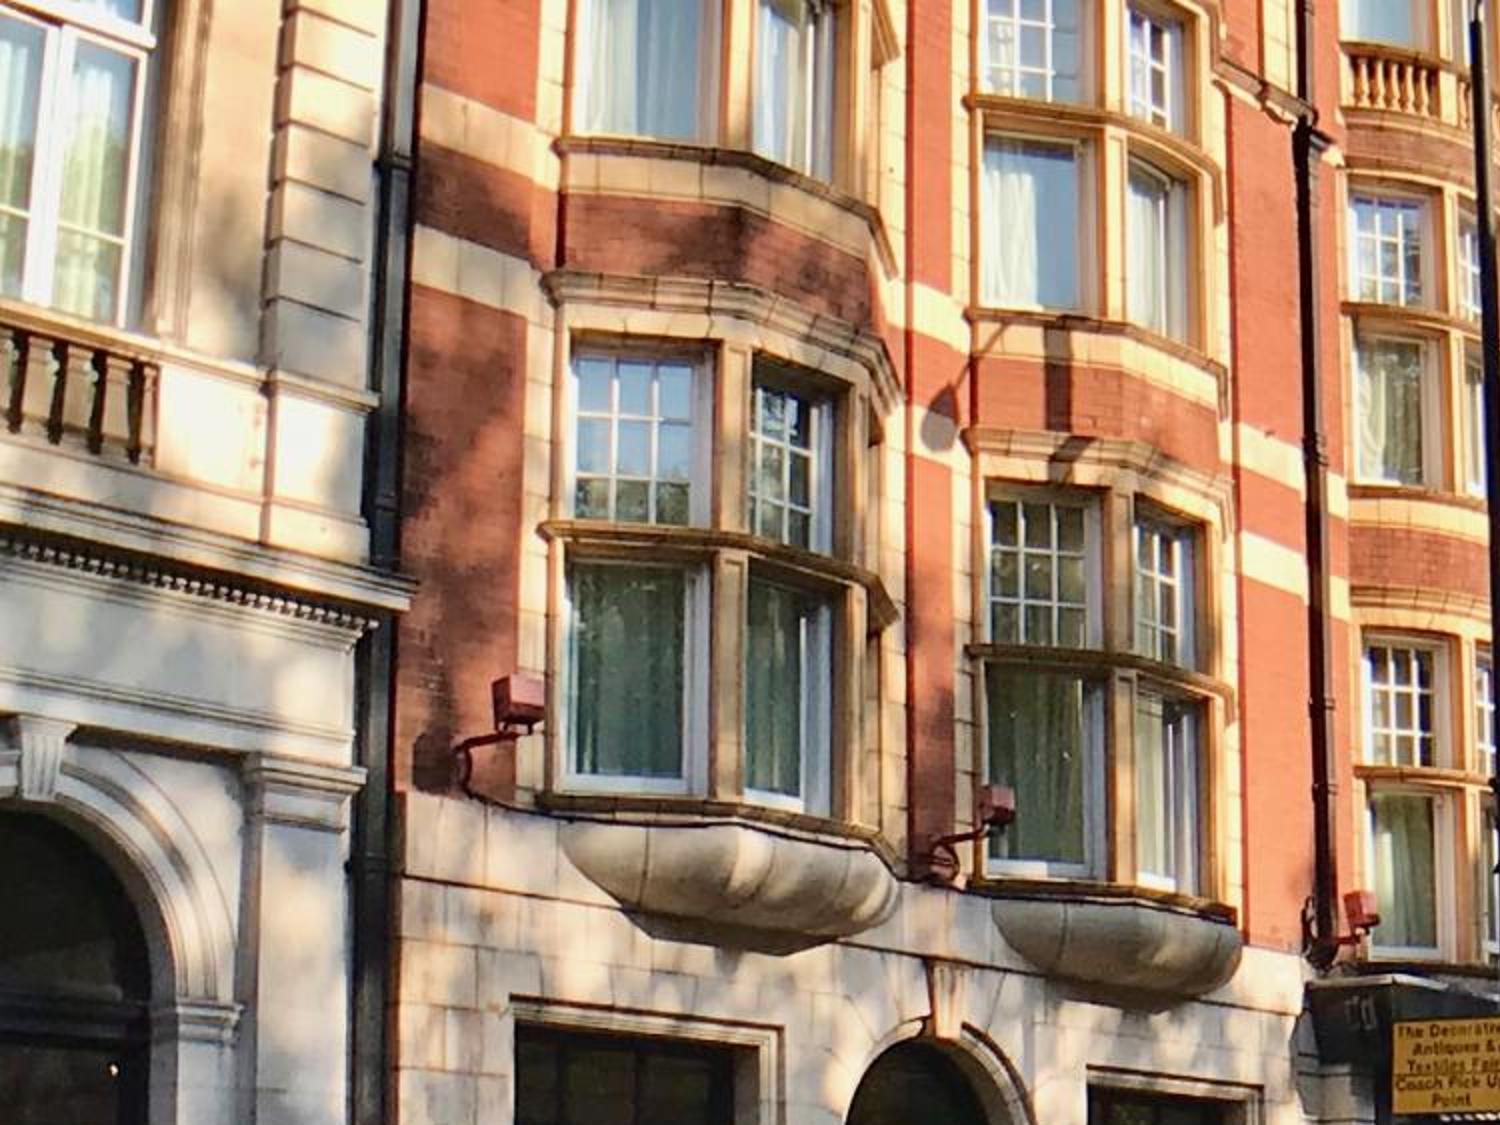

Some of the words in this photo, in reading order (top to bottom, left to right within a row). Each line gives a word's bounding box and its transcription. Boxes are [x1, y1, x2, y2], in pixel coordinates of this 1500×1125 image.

[1398, 1025, 1424, 1038] The
[1412, 1040, 1480, 1056] Antiques
[1486, 1039, 1496, 1053] &
[1407, 1058, 1466, 1073] Textiles
[1472, 1057, 1500, 1071] Fair
[1395, 1074, 1443, 1090] Coach
[1449, 1074, 1481, 1089] Pick
[1431, 1092, 1473, 1107] Point
